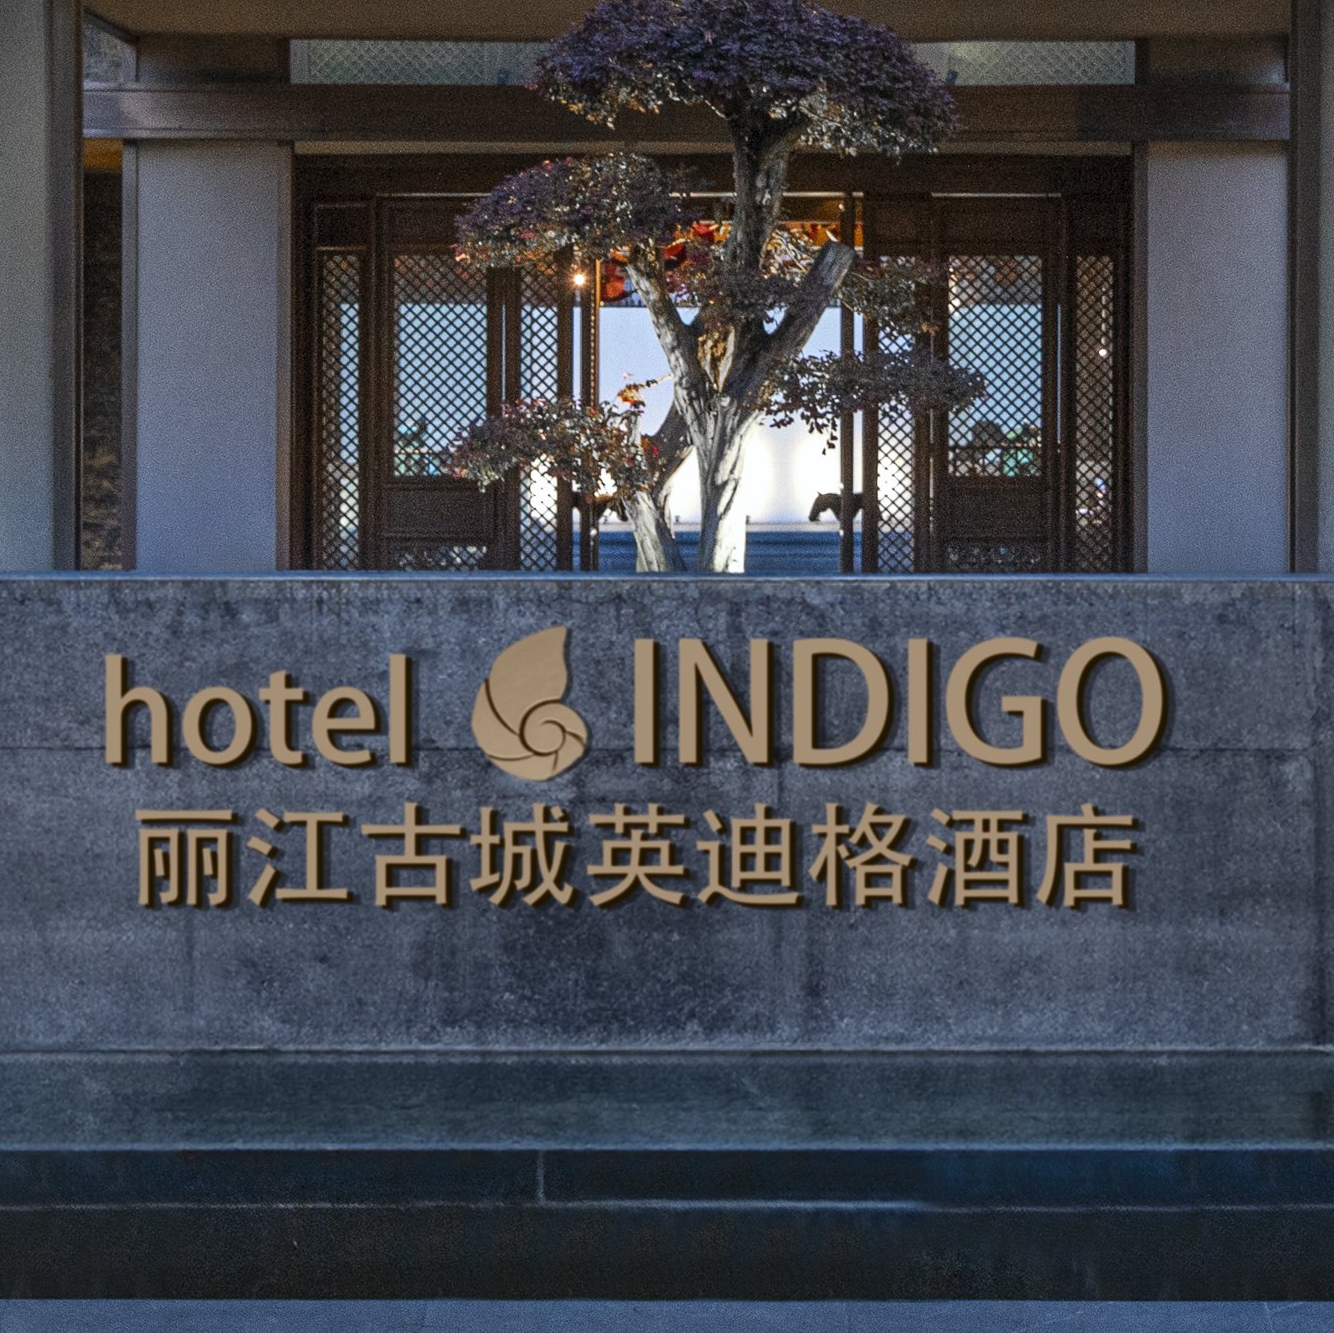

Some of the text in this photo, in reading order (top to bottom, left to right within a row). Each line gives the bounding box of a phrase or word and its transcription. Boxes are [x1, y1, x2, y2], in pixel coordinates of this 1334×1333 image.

[104, 636, 1165, 766] hotel INDIGO
[135, 802, 1137, 907] 丽江古城英迪格酒店
